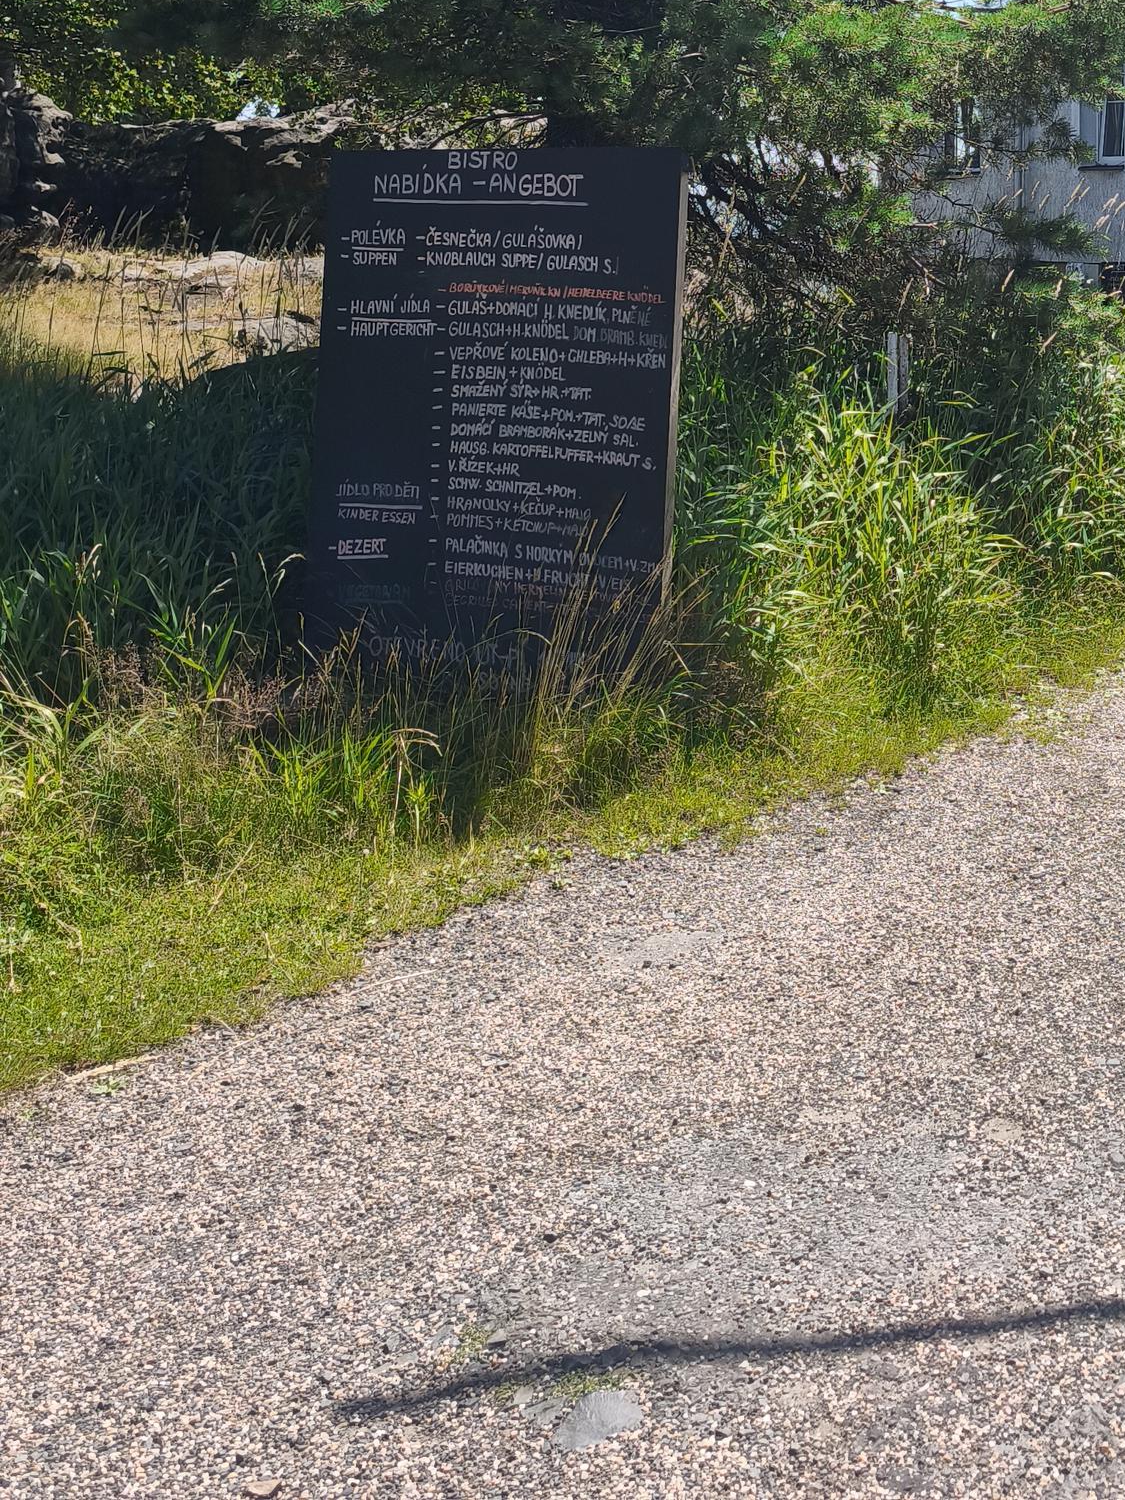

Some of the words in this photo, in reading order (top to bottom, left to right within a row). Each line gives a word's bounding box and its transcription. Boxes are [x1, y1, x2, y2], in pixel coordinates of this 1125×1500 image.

[448, 151, 518, 170] BISTRO
[374, 164, 462, 194] NABÍDKA
[353, 251, 398, 266] SUPPEN
[547, 255, 599, 273] GULASCH
[350, 293, 398, 314] HLAVNÍ
[400, 293, 430, 314] JÍDLA
[350, 320, 438, 337] HAUPTGERICHT
[449, 341, 508, 360] VEPŘOVÉ
[451, 364, 506, 380] EISBEIN
[451, 379, 508, 398] SMAŽENÝ
[451, 402, 507, 417] PANIERTE
[450, 418, 496, 437] DOMÁCÍ
[336, 478, 370, 497] JÍDLO
[373, 483, 393, 497] PRO
[395, 480, 420, 499] DĚTI
[338, 508, 379, 522] KINDER
[381, 511, 416, 525] ESSEN
[445, 534, 508, 559] PALAČINKA
[514, 543, 523, 559] S
